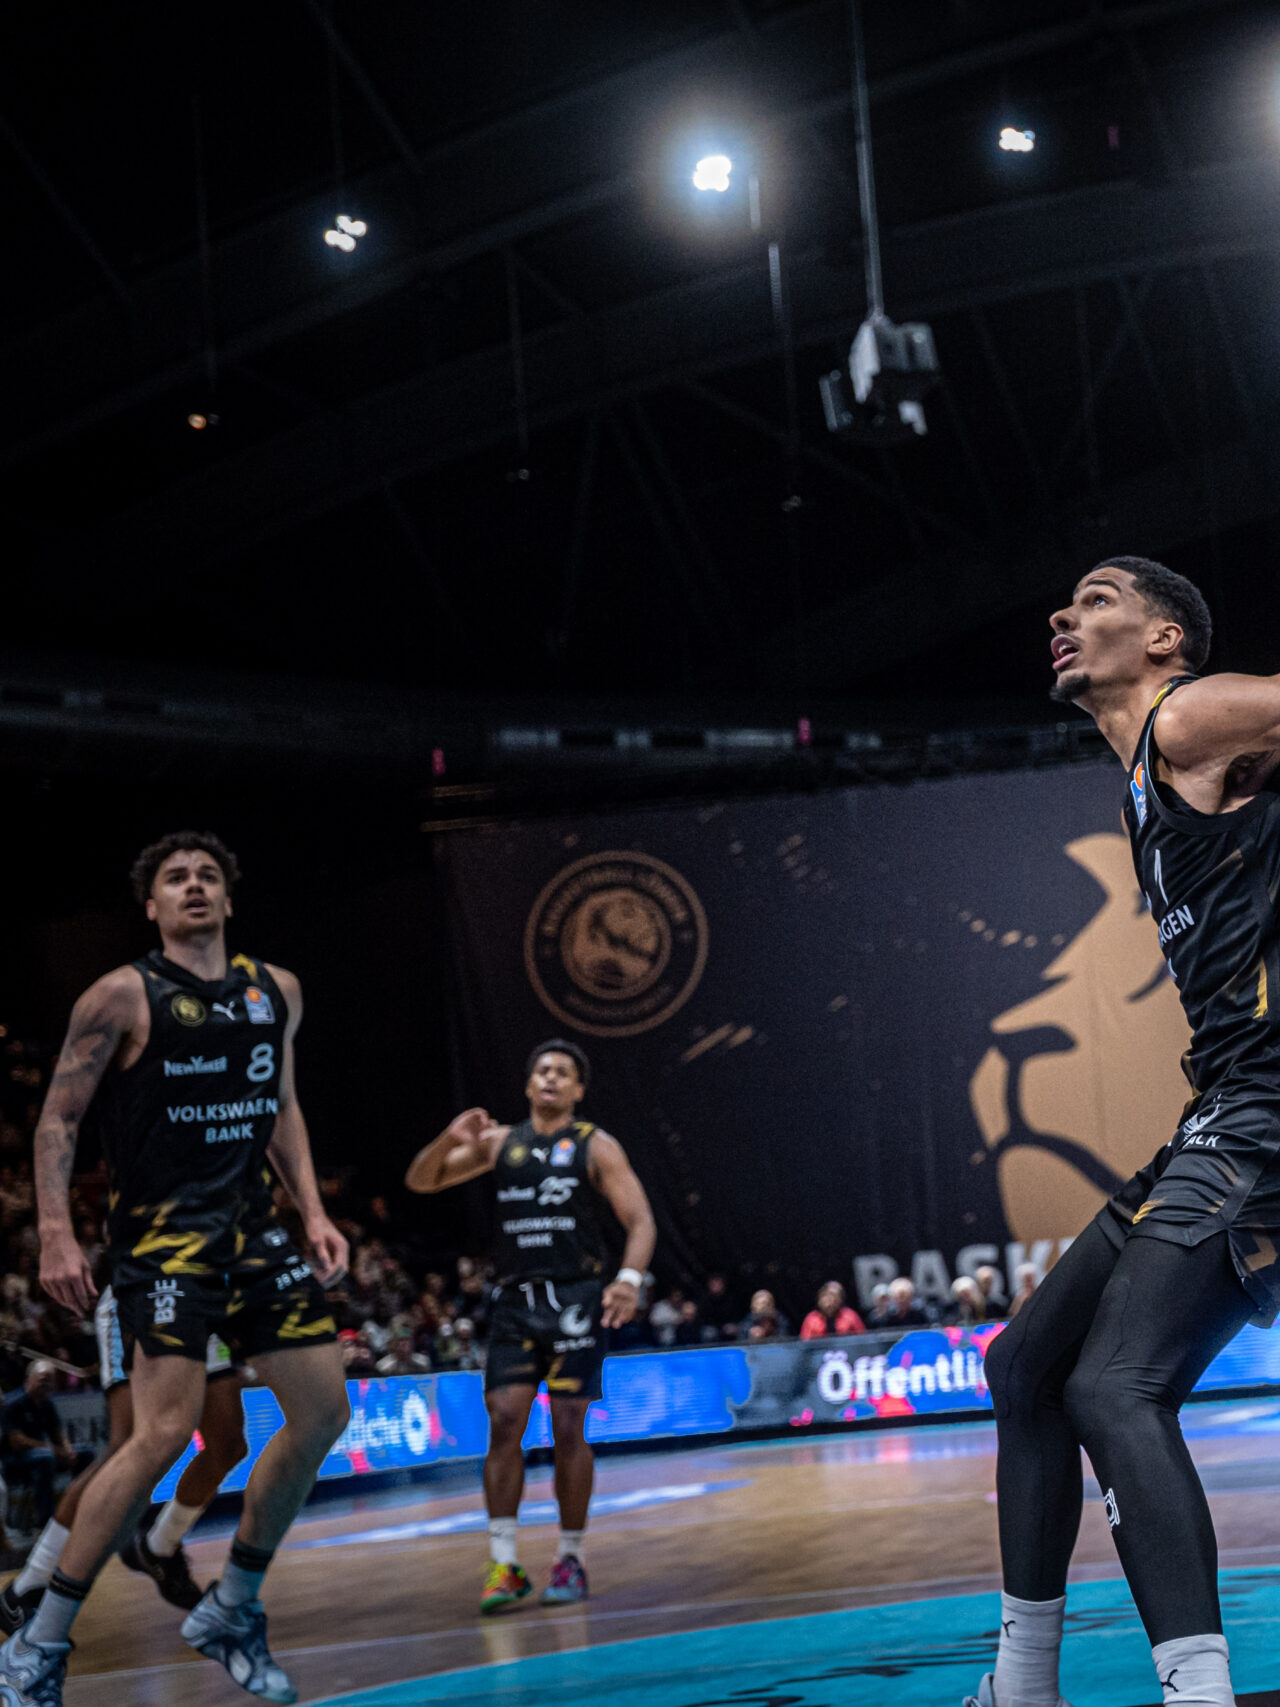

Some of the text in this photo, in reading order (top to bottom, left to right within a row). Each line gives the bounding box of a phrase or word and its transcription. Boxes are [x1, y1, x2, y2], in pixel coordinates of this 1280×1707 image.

[246, 1042, 275, 1083] 8
[205, 1122, 255, 1144] BANK
[817, 1350, 987, 1405] Öffentli
